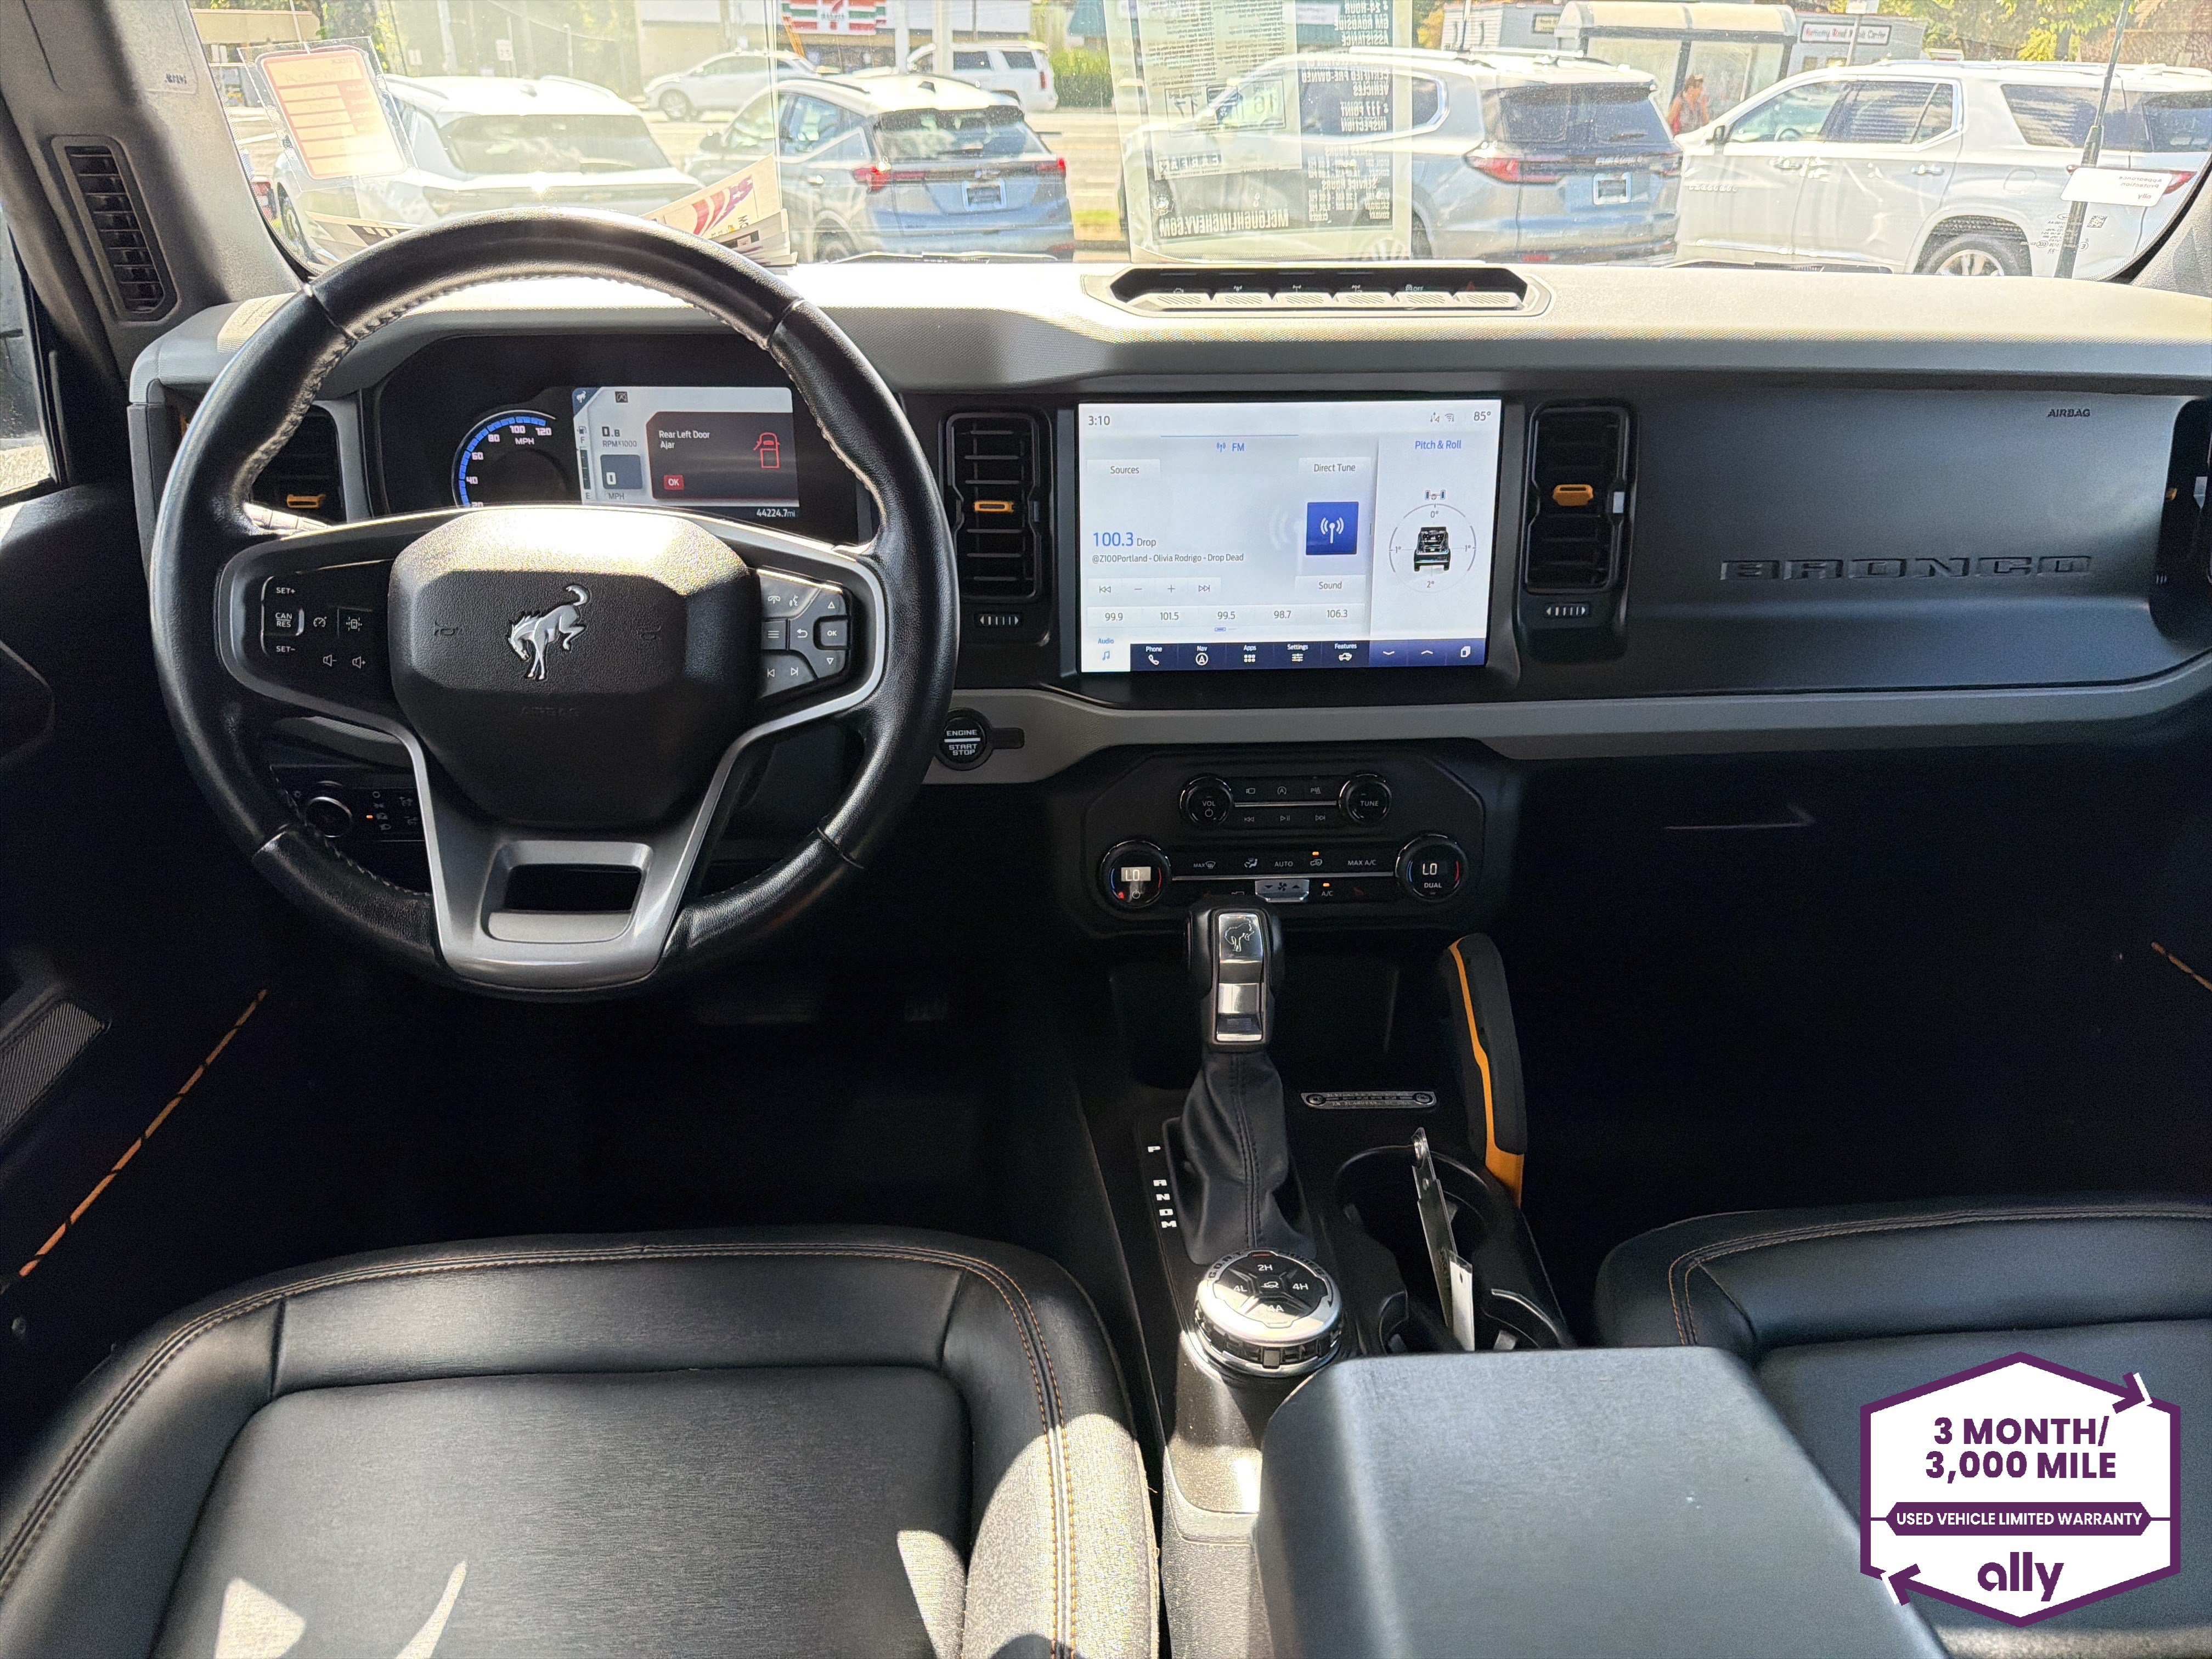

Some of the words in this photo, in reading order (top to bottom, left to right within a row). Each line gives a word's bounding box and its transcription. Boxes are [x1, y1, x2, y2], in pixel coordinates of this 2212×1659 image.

[1474, 411, 1492, 421] 85°
[2047, 408, 2091, 417] AIRBAG
[1088, 415, 1110, 426] 3:10
[509, 425, 526, 434] 100
[535, 427, 552, 436] 120
[659, 430, 676, 438] Rear
[677, 430, 692, 439] Left
[693, 430, 710, 439] Door
[660, 441, 675, 450] Ajar
[1232, 443, 1245, 452] FM
[1415, 440, 1436, 449] Pitch
[1437, 441, 1444, 449] &
[1446, 440, 1462, 449] Roll
[471, 452, 484, 460] 60
[1110, 465, 1139, 475] Sources
[1313, 463, 1335, 472] Direct
[1337, 463, 1356, 472] Tune
[466, 476, 478, 484] 40
[606, 472, 617, 485] 0
[1093, 532, 1134, 547] 100.3
[1137, 538, 1156, 549] Drop
[1092, 554, 1148, 563] @Z100Portland
[1153, 554, 1173, 562] Olivia
[1175, 554, 1202, 564] Rodrigo
[1207, 554, 1224, 563] Drop
[1226, 554, 1244, 562] Dead
[1720, 556, 2091, 580] BRONCO
[1318, 581, 1342, 590] Sound
[1105, 612, 1123, 621] 99.9
[1160, 612, 1179, 621] 101.5
[1217, 611, 1235, 620] 99.5
[1273, 610, 1291, 619] 98.7
[1327, 610, 1348, 618] 106.3
[1243, 644, 1256, 652] Apps
[1423, 863, 1438, 876] LO
